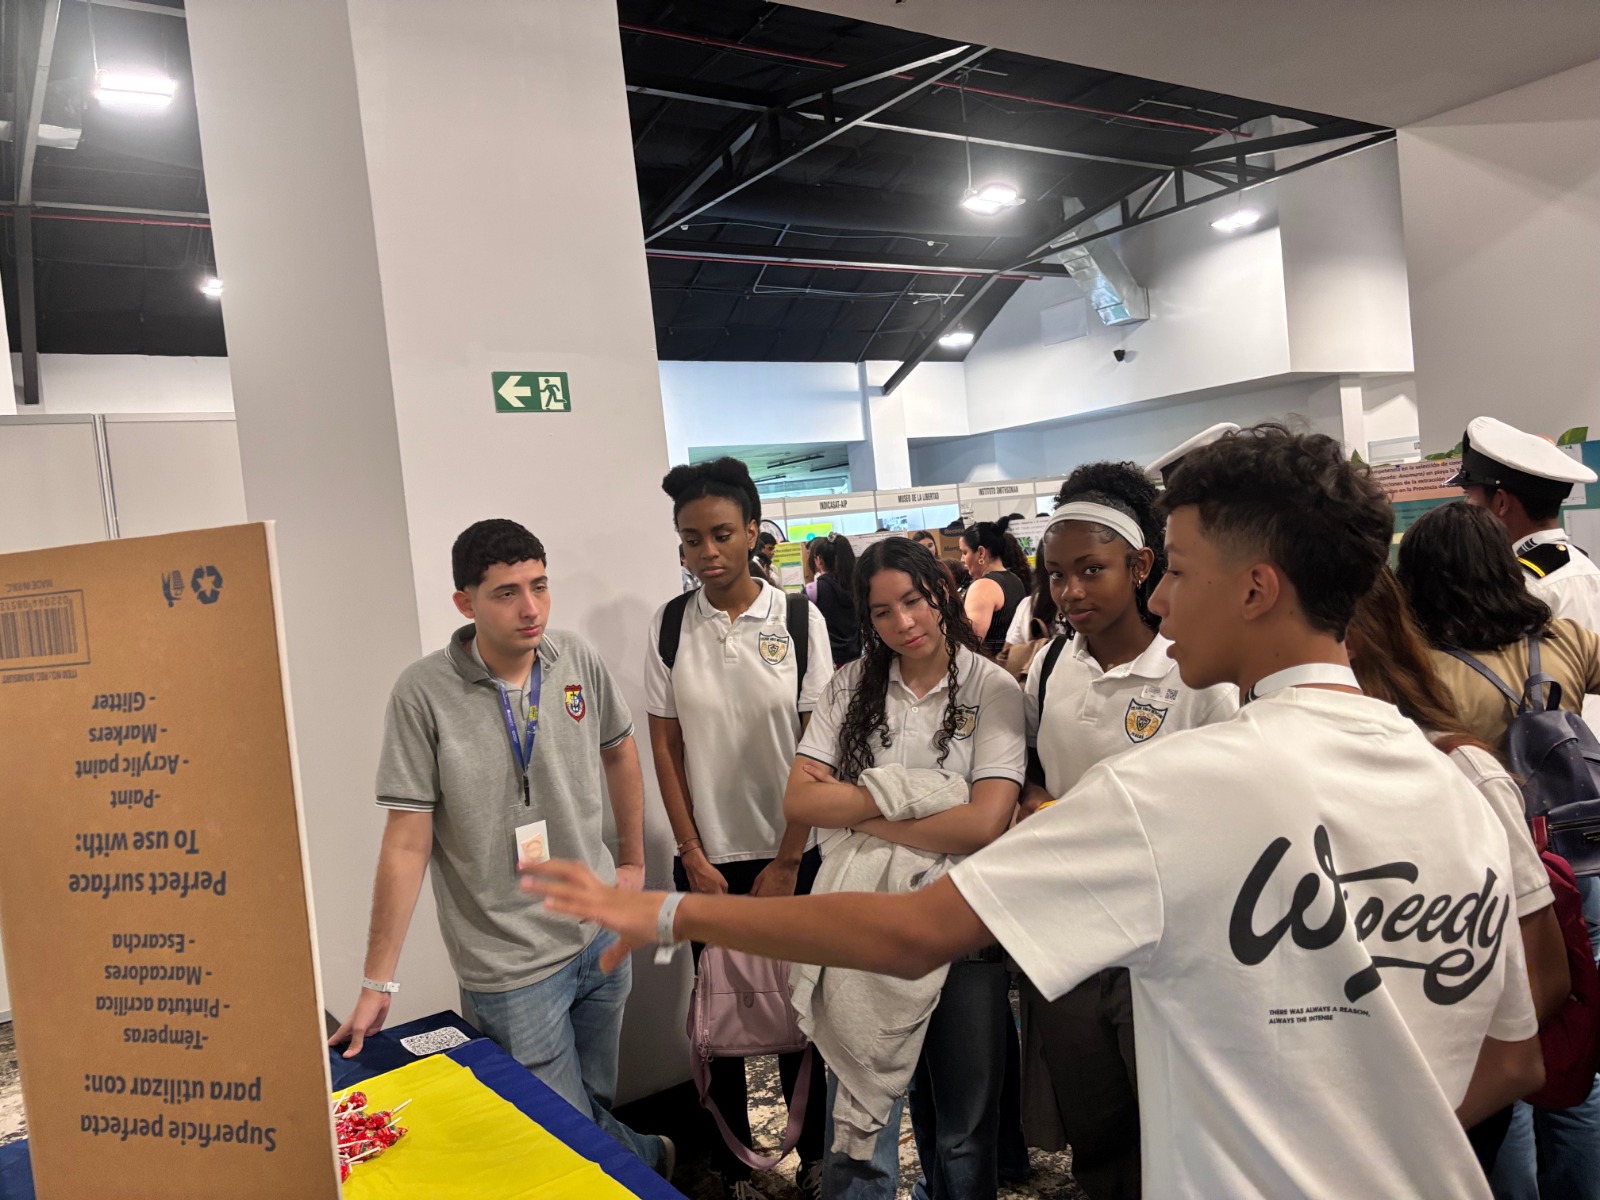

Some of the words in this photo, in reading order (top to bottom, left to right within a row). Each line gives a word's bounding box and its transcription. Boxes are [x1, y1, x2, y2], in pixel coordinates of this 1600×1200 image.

[819, 500, 848, 510] INDICASAT-AIP
[898, 495, 911, 503] MUSEO
[911, 494, 917, 502] DE
[922, 492, 939, 501] LIBERTAD
[92, 691, 146, 713] Glitter
[89, 724, 157, 746] Markers
[75, 753, 119, 779] paint
[122, 752, 180, 777] Acrylic
[75, 832, 128, 858] with:
[133, 830, 168, 851] use
[174, 830, 200, 855] To
[68, 872, 145, 900] surface
[149, 870, 227, 898] Perfect
[112, 933, 185, 954] Escarcha
[104, 964, 202, 985] Marcadores
[96, 996, 154, 1017] acrílica
[157, 997, 220, 1018] Pintuta
[84, 1073, 126, 1095] con:
[130, 1076, 205, 1105] utilizar
[210, 1076, 262, 1102] para
[80, 1114, 164, 1142] perfecta
[168, 1119, 277, 1152] Superficie
